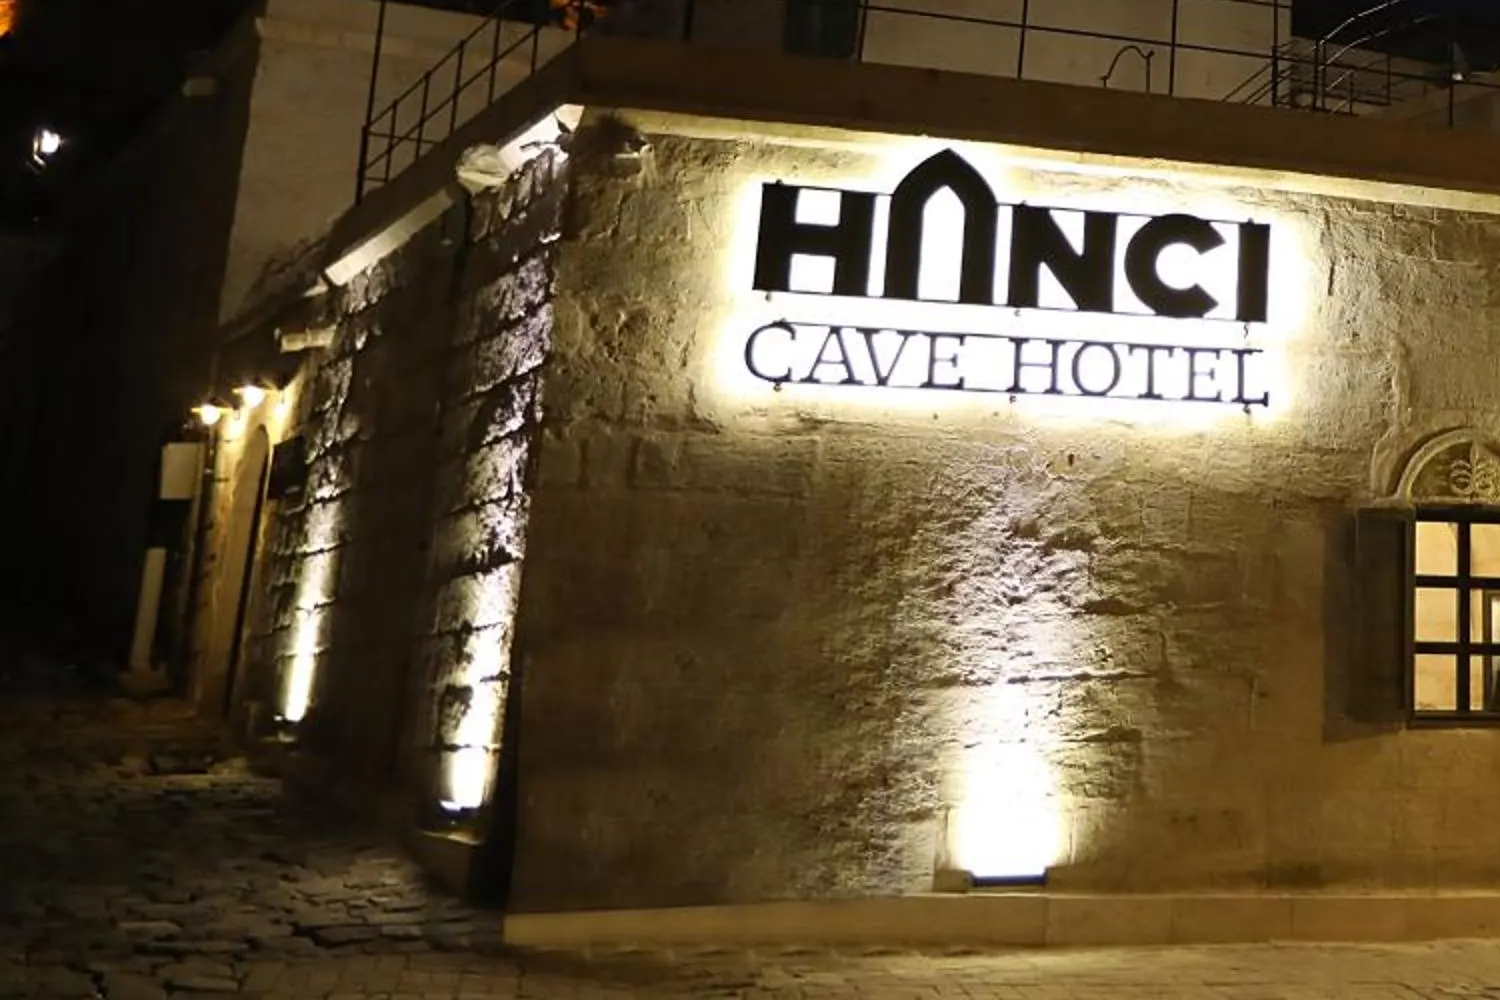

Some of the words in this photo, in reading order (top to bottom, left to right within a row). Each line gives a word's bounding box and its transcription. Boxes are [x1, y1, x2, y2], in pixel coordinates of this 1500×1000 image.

[753, 148, 1271, 322] HANCI
[744, 321, 966, 389] CAVE
[1007, 337, 1269, 406] HOTEL
